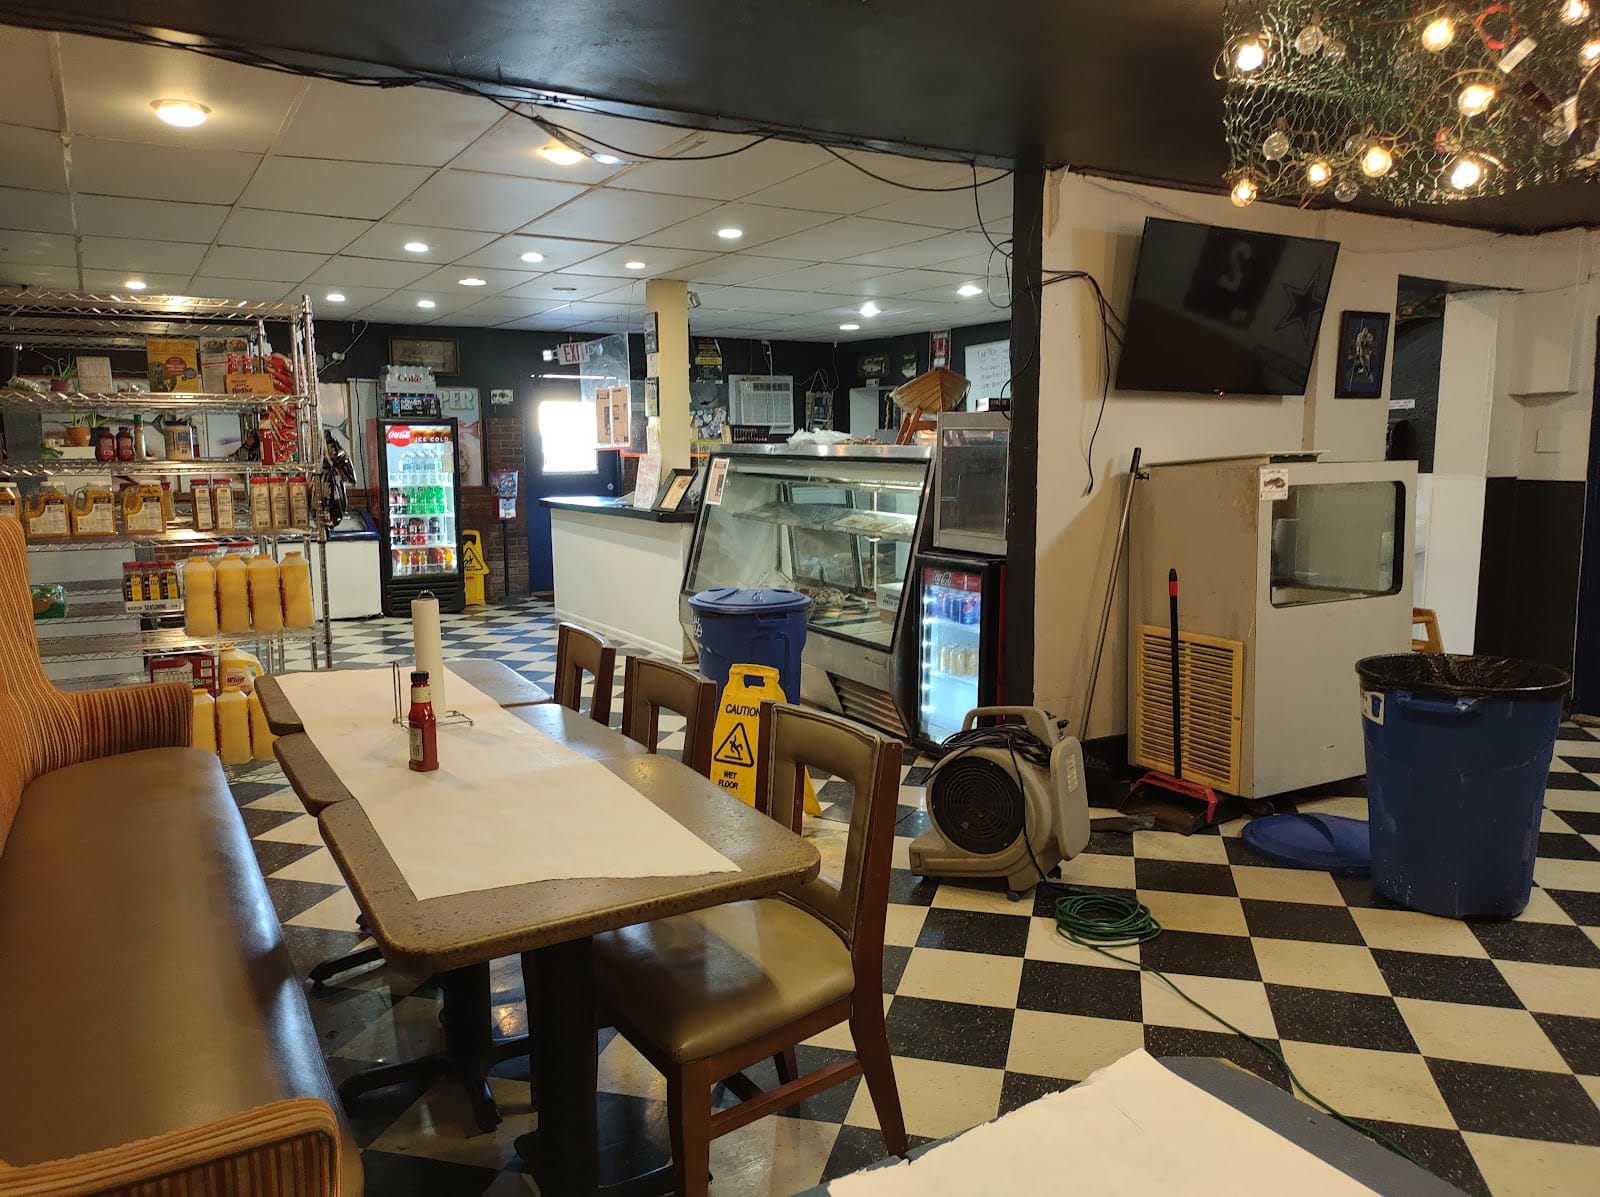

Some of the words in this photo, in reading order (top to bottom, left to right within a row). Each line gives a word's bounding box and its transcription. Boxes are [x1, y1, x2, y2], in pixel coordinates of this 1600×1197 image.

[563, 343, 585, 363] EXIT
[725, 703, 760, 717] CAUTION
[723, 769, 738, 779] WET
[717, 779, 739, 790] FLOOR
